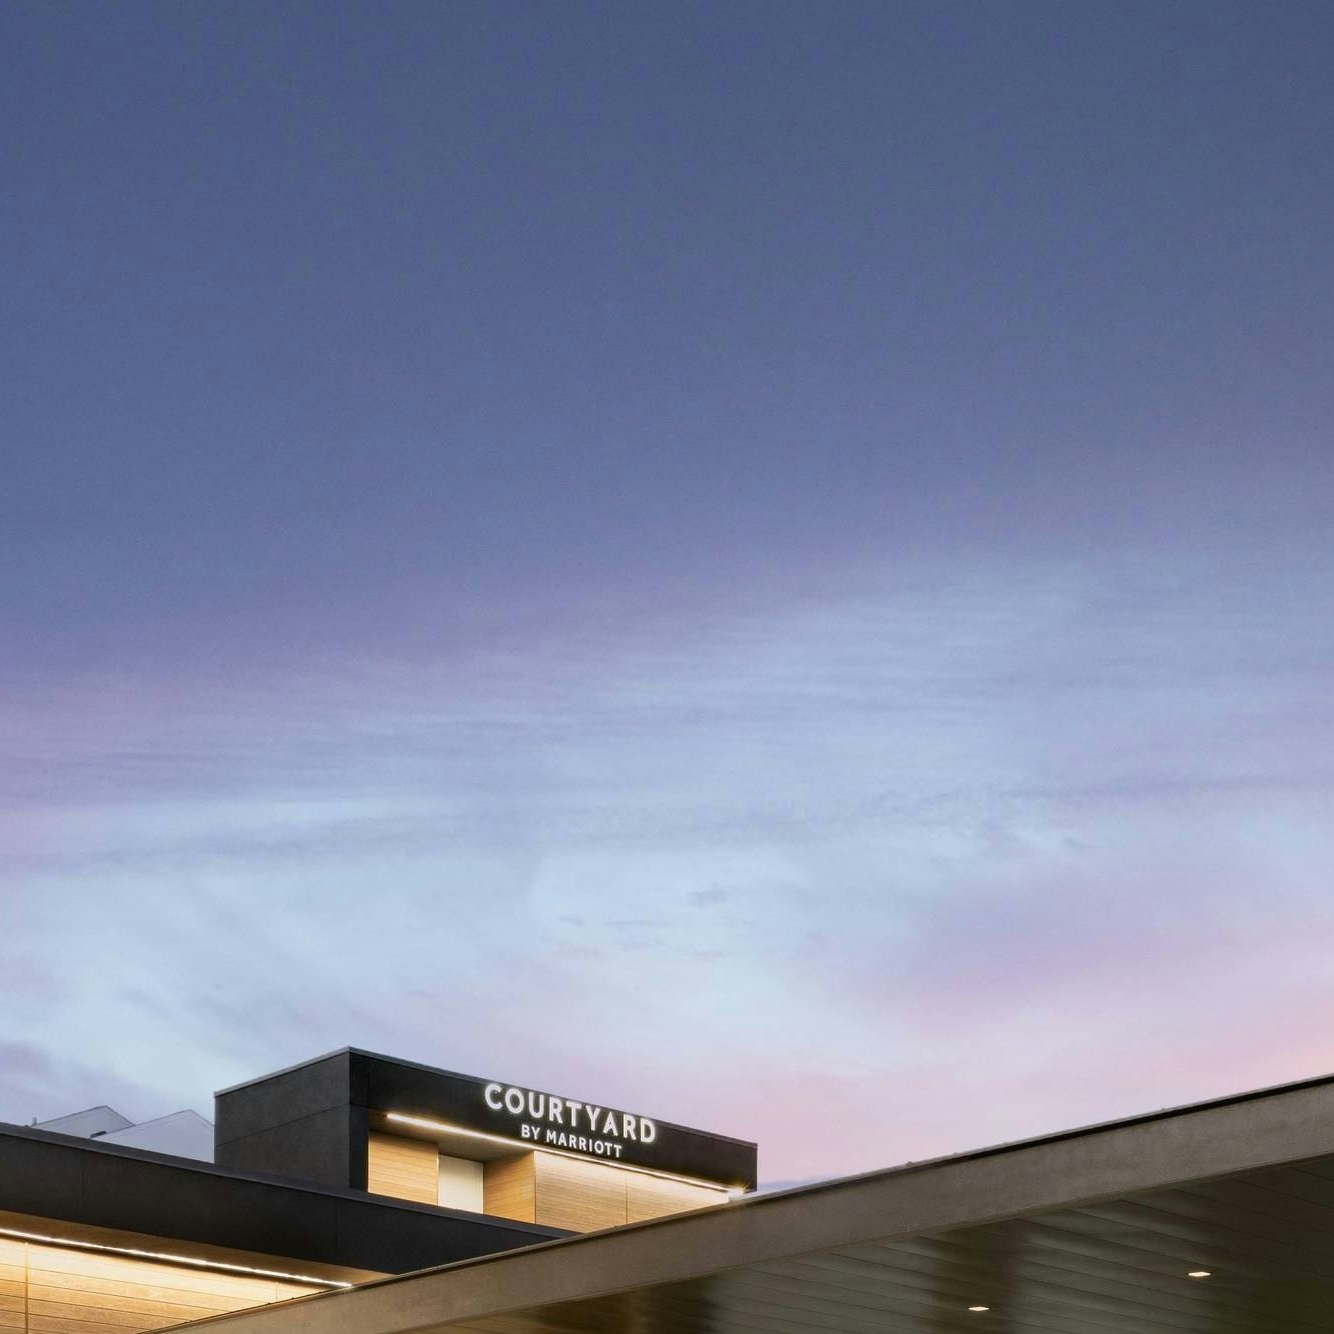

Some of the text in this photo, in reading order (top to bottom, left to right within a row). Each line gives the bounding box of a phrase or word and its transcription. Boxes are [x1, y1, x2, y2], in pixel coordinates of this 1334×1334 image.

[484, 1083, 656, 1143] COURTYARD
[521, 1124, 622, 1158] BY MARRIOTT
